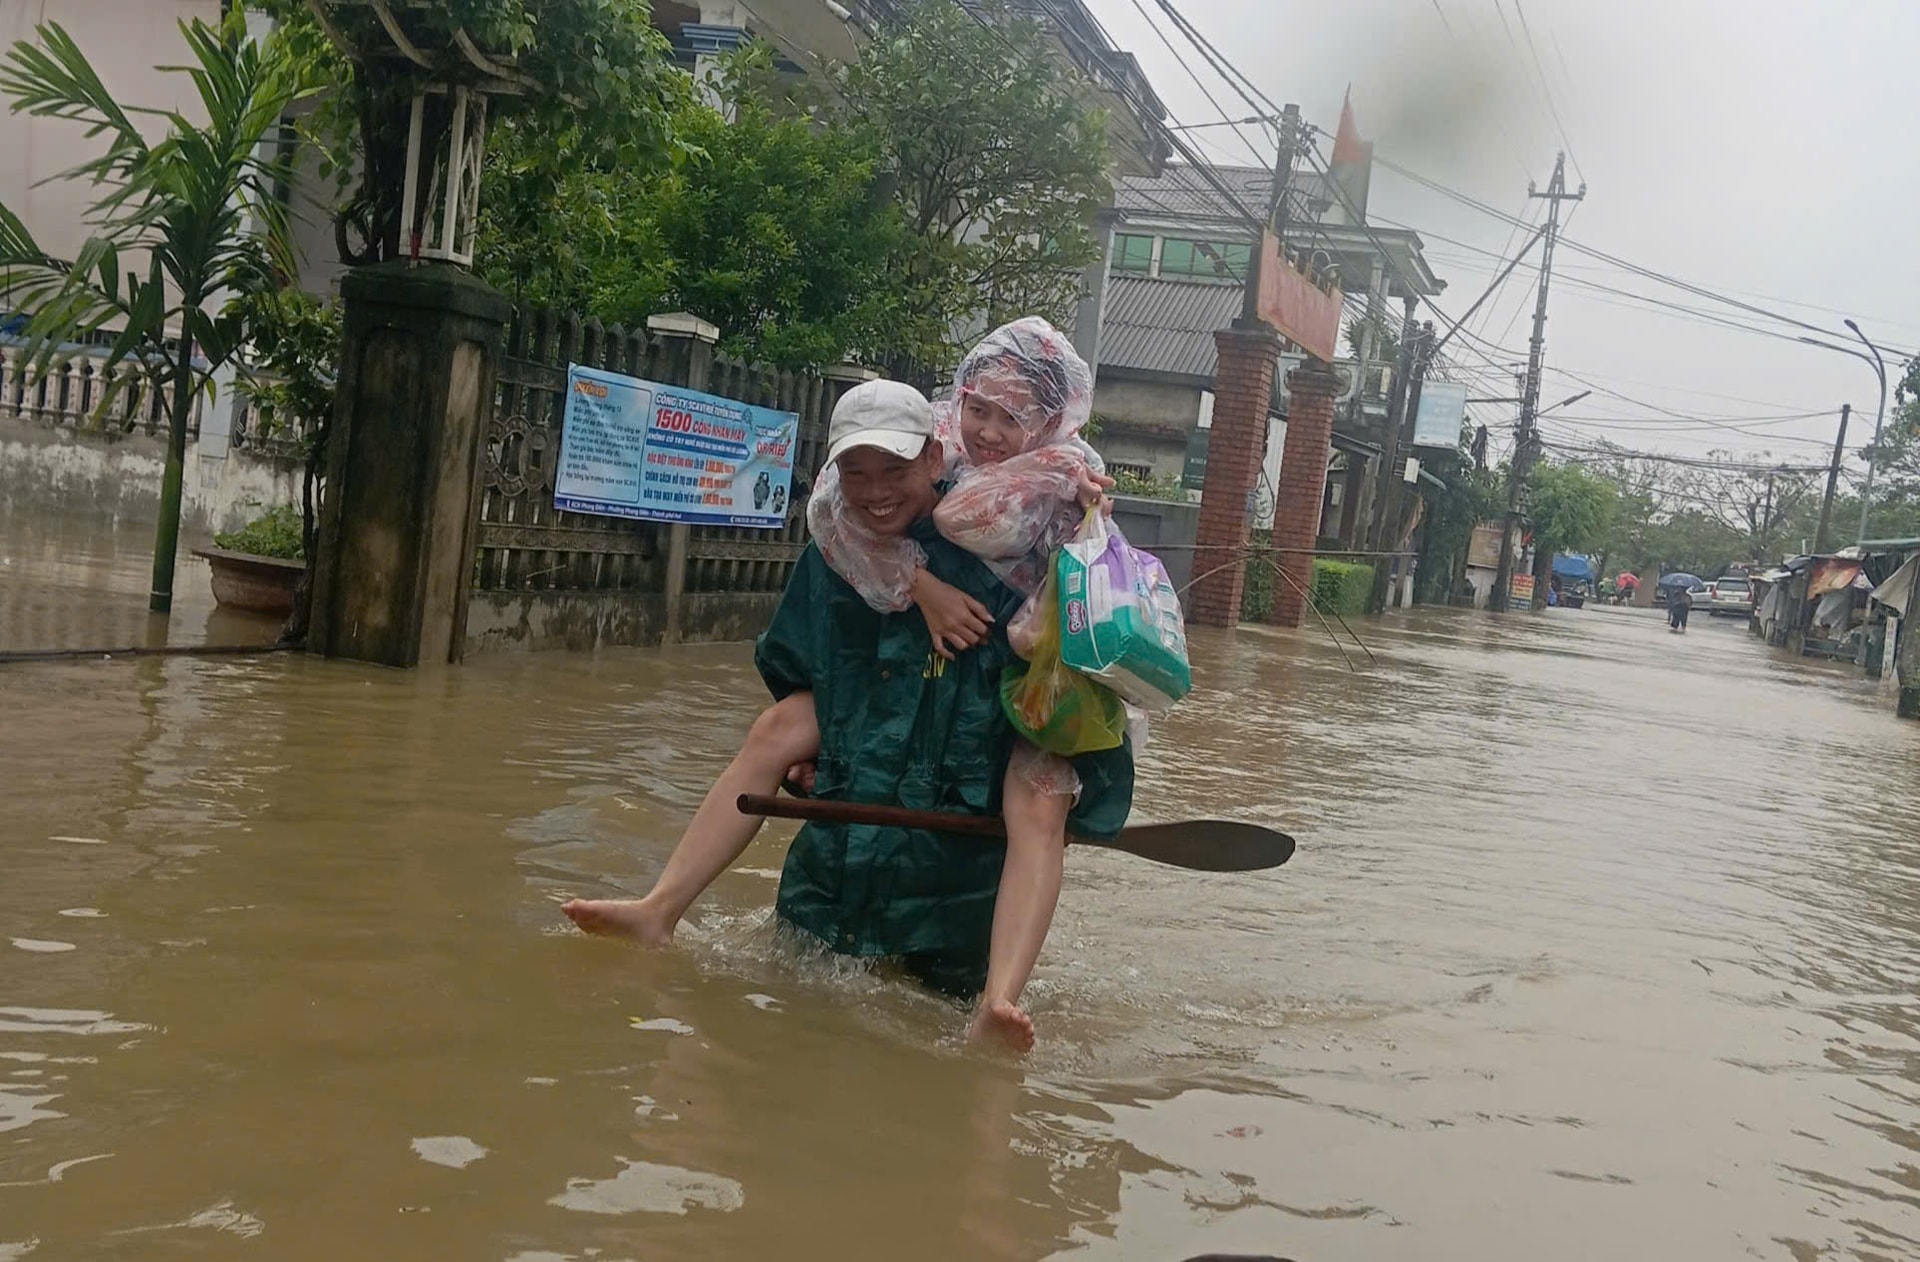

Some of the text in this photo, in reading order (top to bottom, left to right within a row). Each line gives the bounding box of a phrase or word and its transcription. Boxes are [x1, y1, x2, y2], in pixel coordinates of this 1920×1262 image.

[656, 391, 677, 406] CÔNG
[677, 398, 688, 409] TY
[656, 409, 692, 432] 1500
[693, 418, 711, 435] CÔNG
